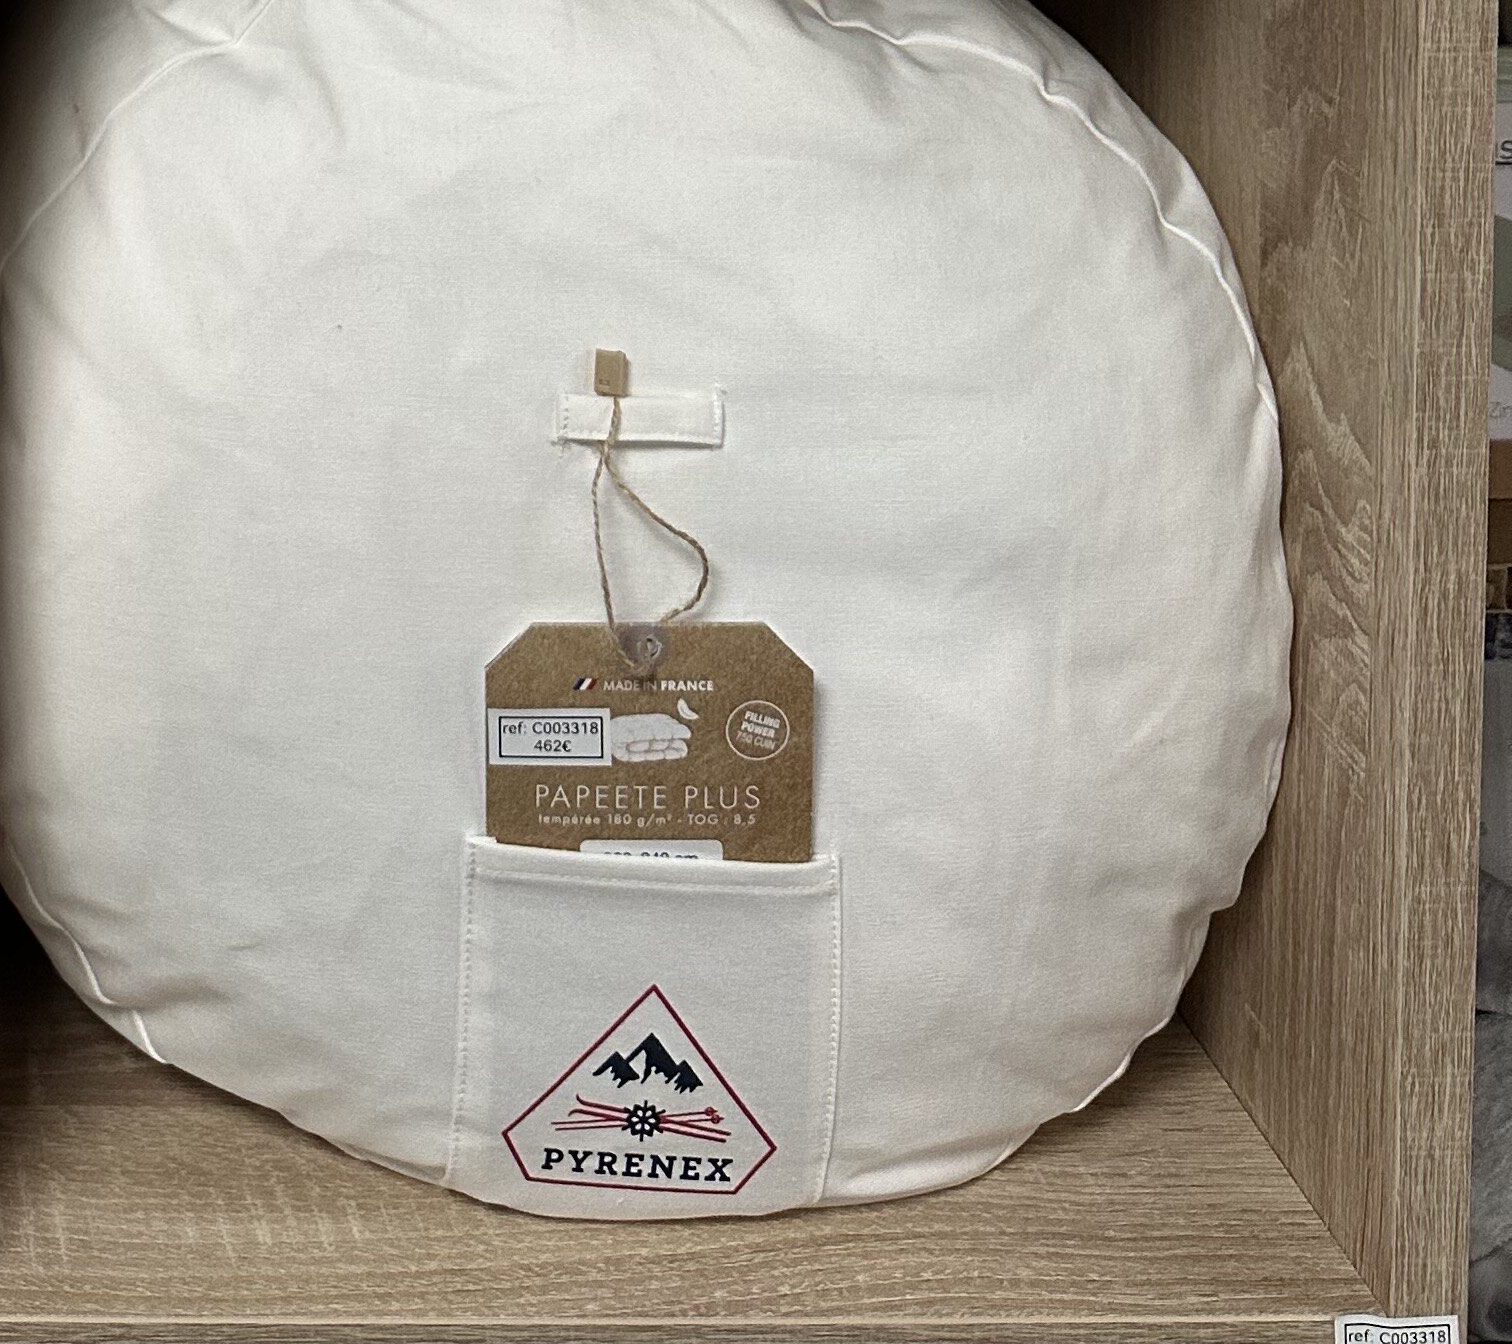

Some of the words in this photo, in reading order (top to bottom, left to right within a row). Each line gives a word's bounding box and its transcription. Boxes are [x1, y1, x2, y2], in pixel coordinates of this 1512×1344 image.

[603, 680, 640, 691] MADE
[643, 681, 657, 691] IN
[660, 680, 714, 691] FRANCE
[744, 710, 781, 729] FILLING
[502, 721, 527, 734] ref:
[532, 722, 598, 734] C003318
[741, 721, 776, 738] POWER
[534, 740, 571, 752] 462€
[536, 784, 667, 810] PAPEETE
[684, 785, 761, 810] PLUS
[539, 813, 601, 826] tempérée
[607, 813, 632, 825] 180
[687, 813, 719, 825] TOG
[541, 1147, 734, 1182] PYRENEX
[1380, 1330, 1446, 1344] C003318
